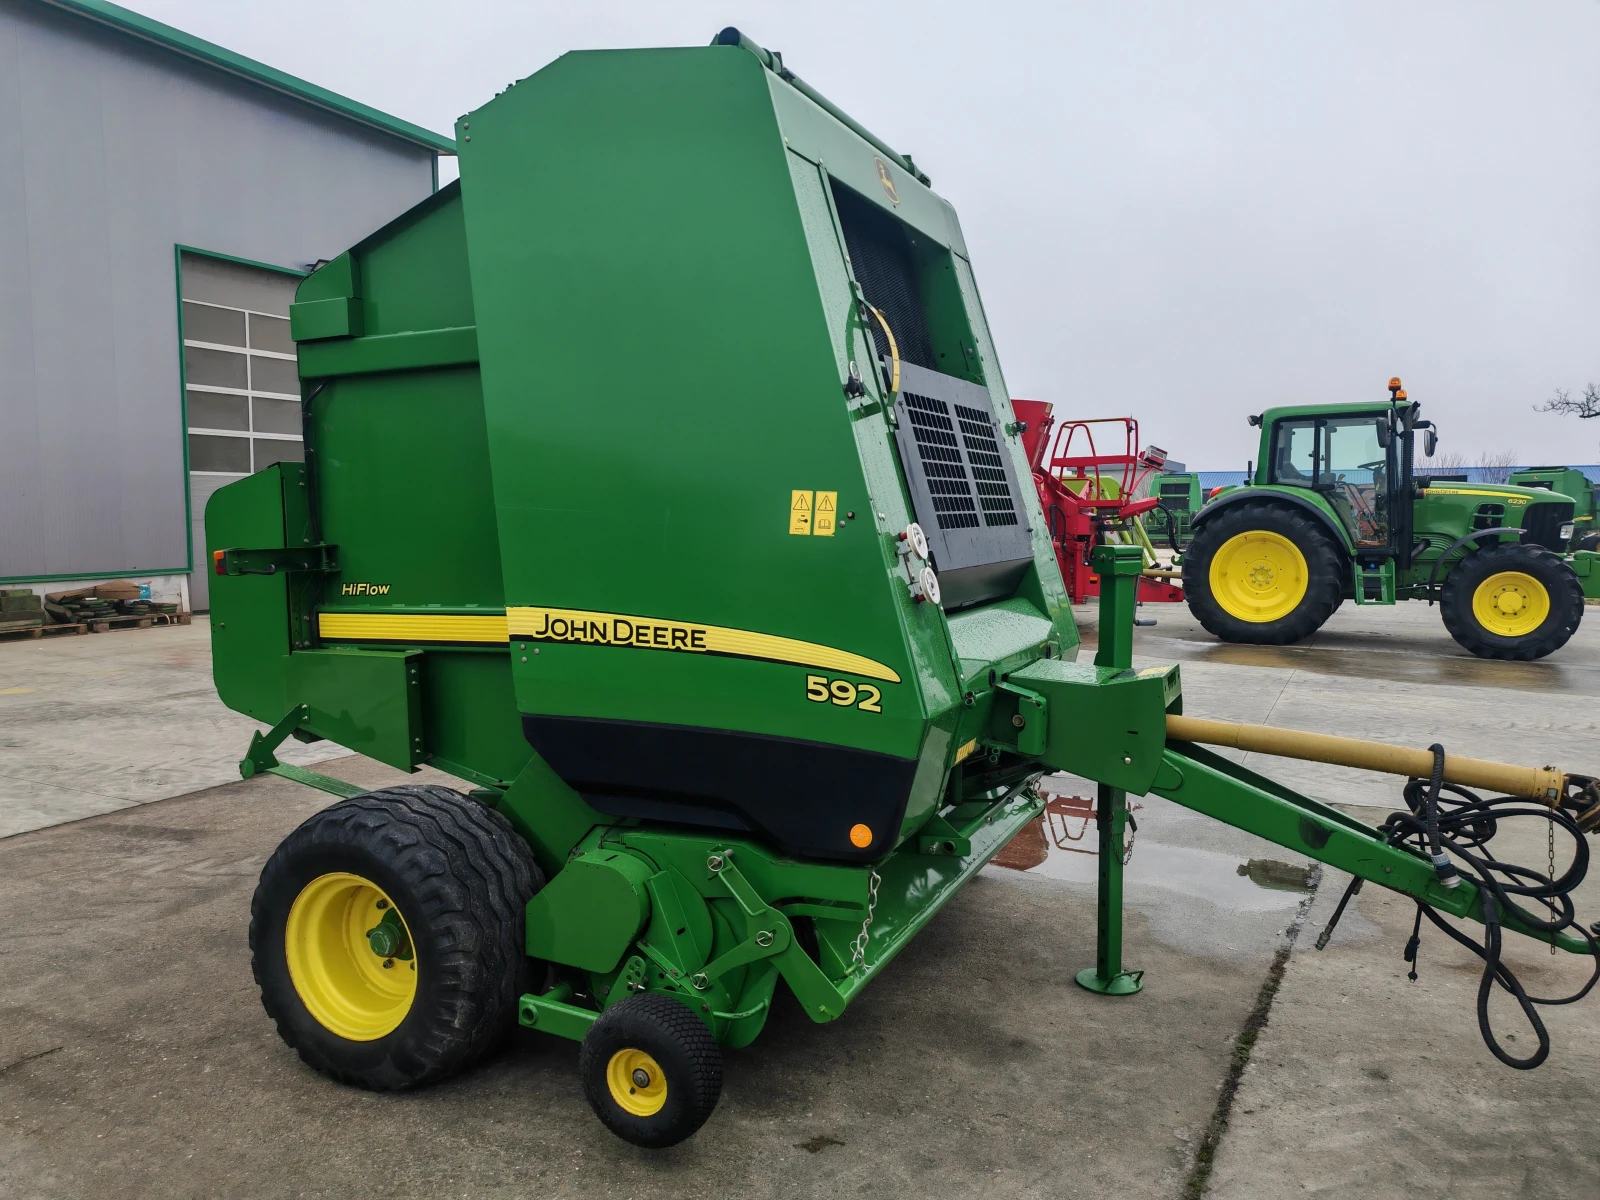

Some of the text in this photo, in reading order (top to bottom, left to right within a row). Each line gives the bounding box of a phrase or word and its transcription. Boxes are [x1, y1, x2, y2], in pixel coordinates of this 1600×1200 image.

[341, 583, 391, 596] HiFlow
[534, 612, 708, 650] JOHN DEERE
[806, 674, 883, 714] 592
